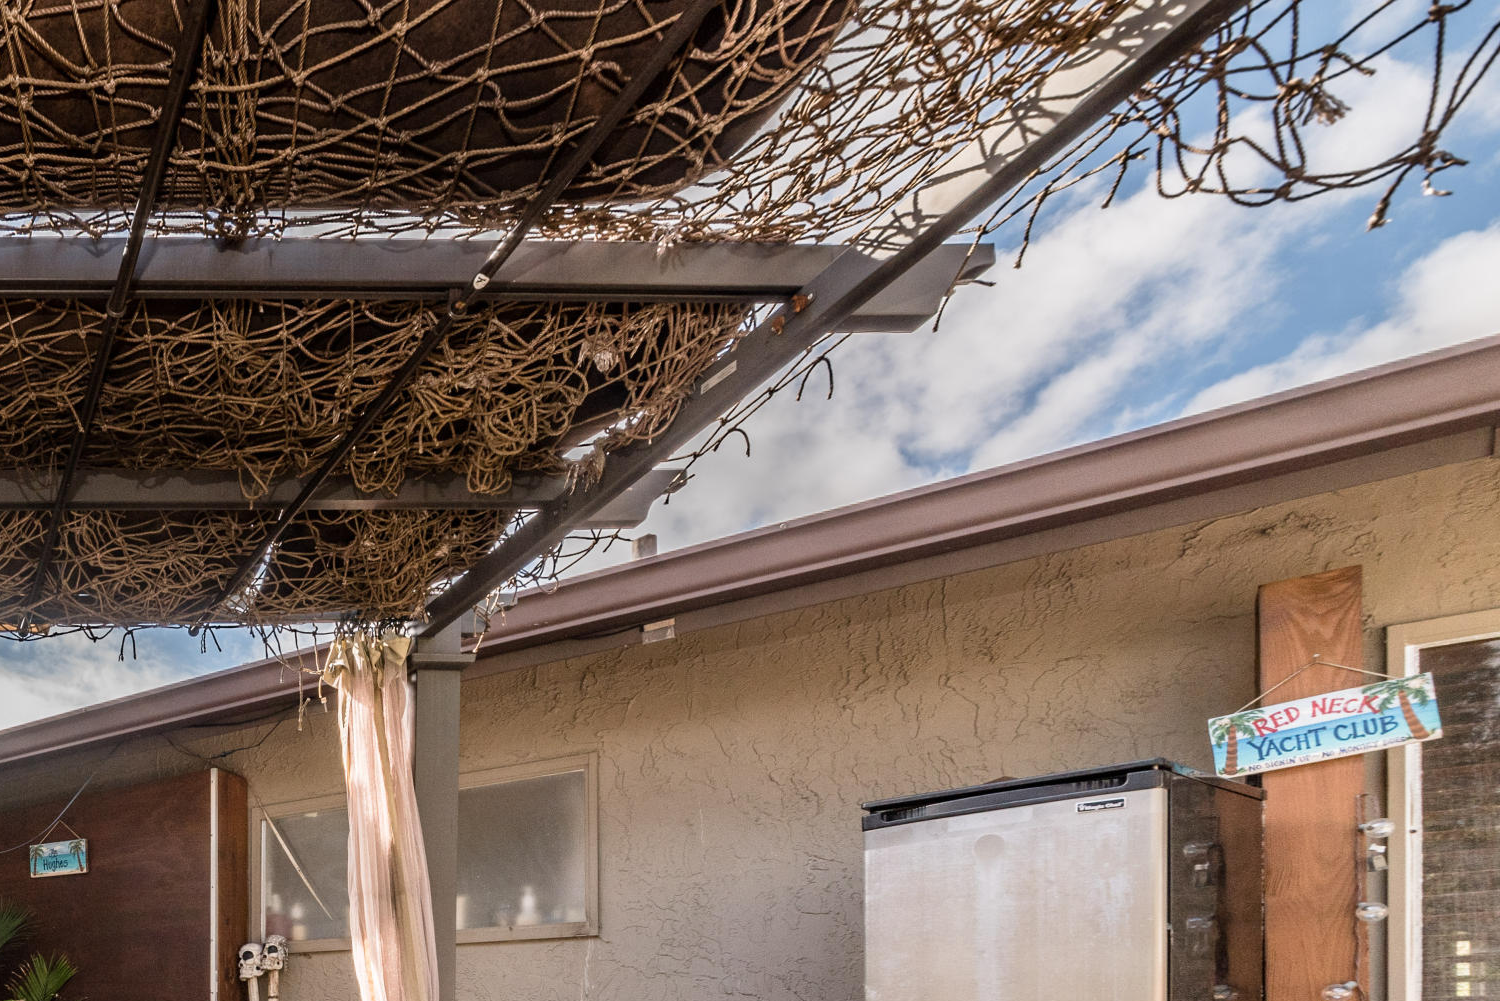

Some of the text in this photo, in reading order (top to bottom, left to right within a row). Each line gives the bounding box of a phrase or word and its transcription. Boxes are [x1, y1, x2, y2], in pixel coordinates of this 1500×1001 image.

[1252, 695, 1381, 737] RED NECK
[1247, 715, 1399, 761] YACHT CLUB
[43, 857, 69, 872] Hughes
